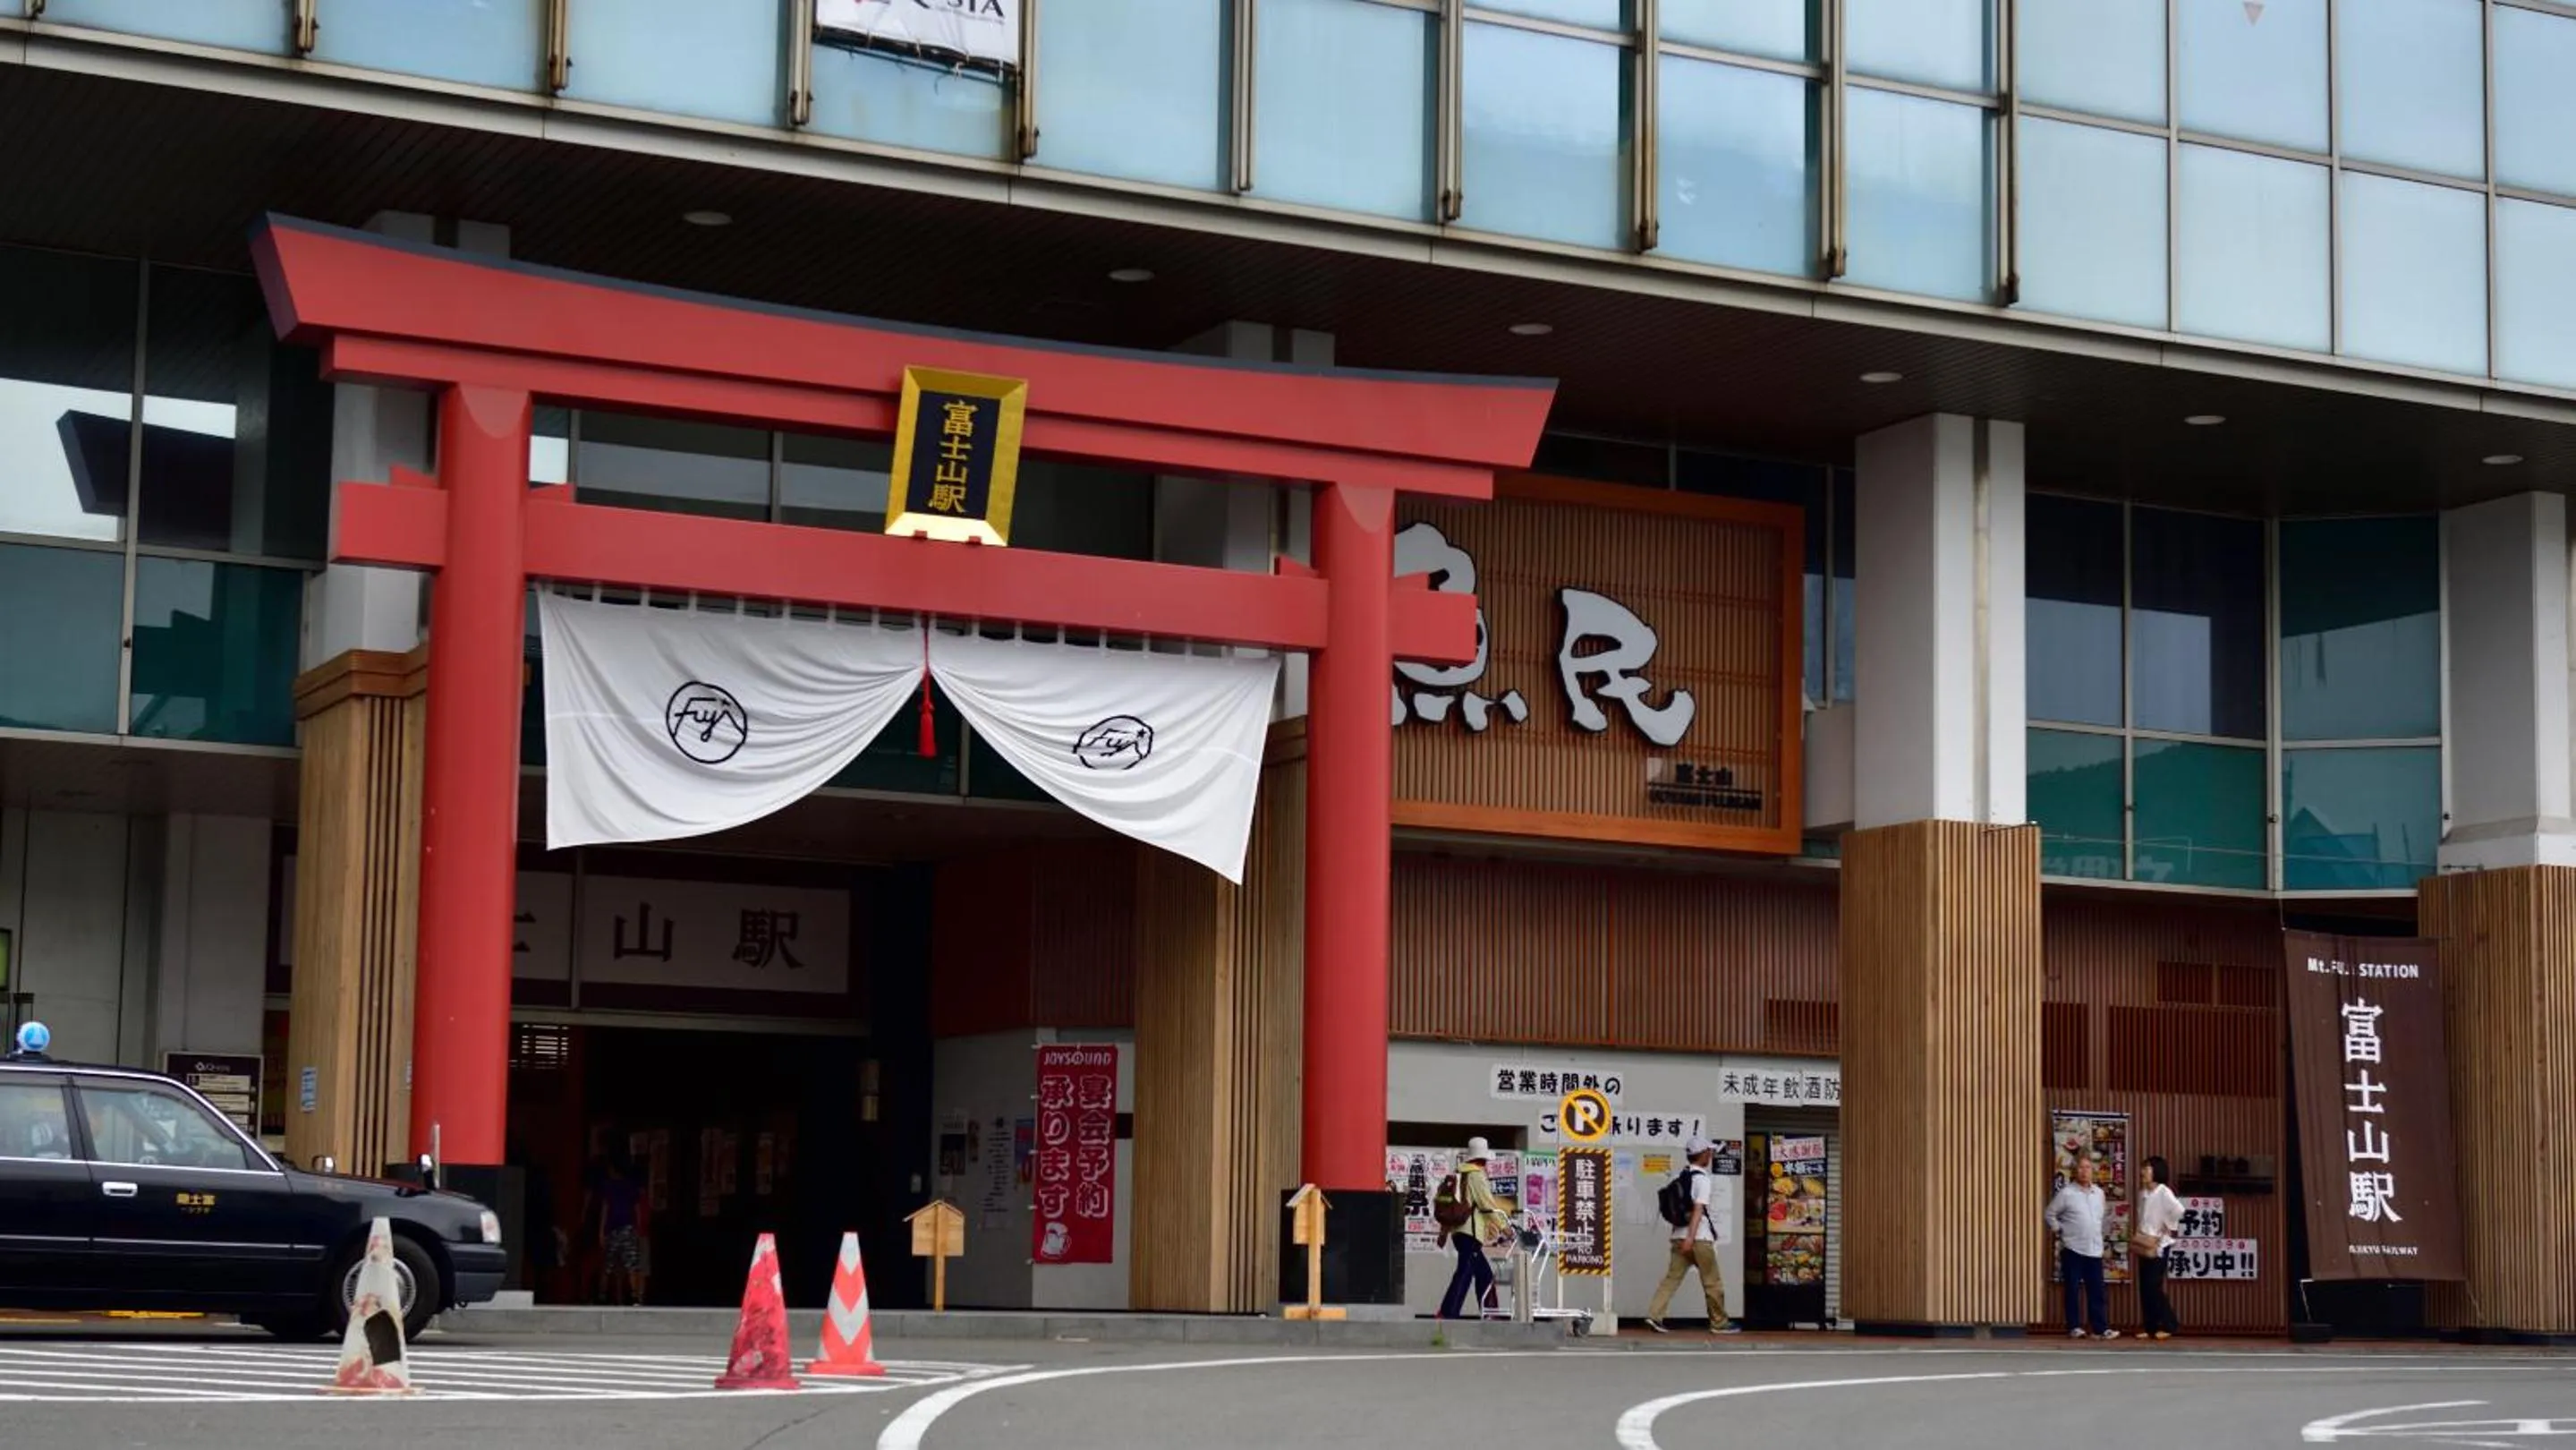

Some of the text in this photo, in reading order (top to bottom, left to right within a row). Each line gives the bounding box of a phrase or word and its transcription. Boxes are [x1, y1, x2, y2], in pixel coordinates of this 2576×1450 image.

[928, 399, 979, 514] 富士山駅
[2359, 962, 2419, 979] STATION
[1043, 1049, 1112, 1066] JOYSOUND
[1497, 1068, 1621, 1096] 営業時間外の
[1723, 1071, 1841, 1101] 未成年飲酒防
[2340, 996, 2403, 1224] 富士山駅
[1038, 1074, 1075, 1219] 承ります
[1076, 1073, 1113, 1219] 宴会予約
[1575, 1158, 1596, 1244] 駐車禁止
[2179, 1208, 2223, 1236] 予約
[1566, 1255, 1603, 1265] PARKING
